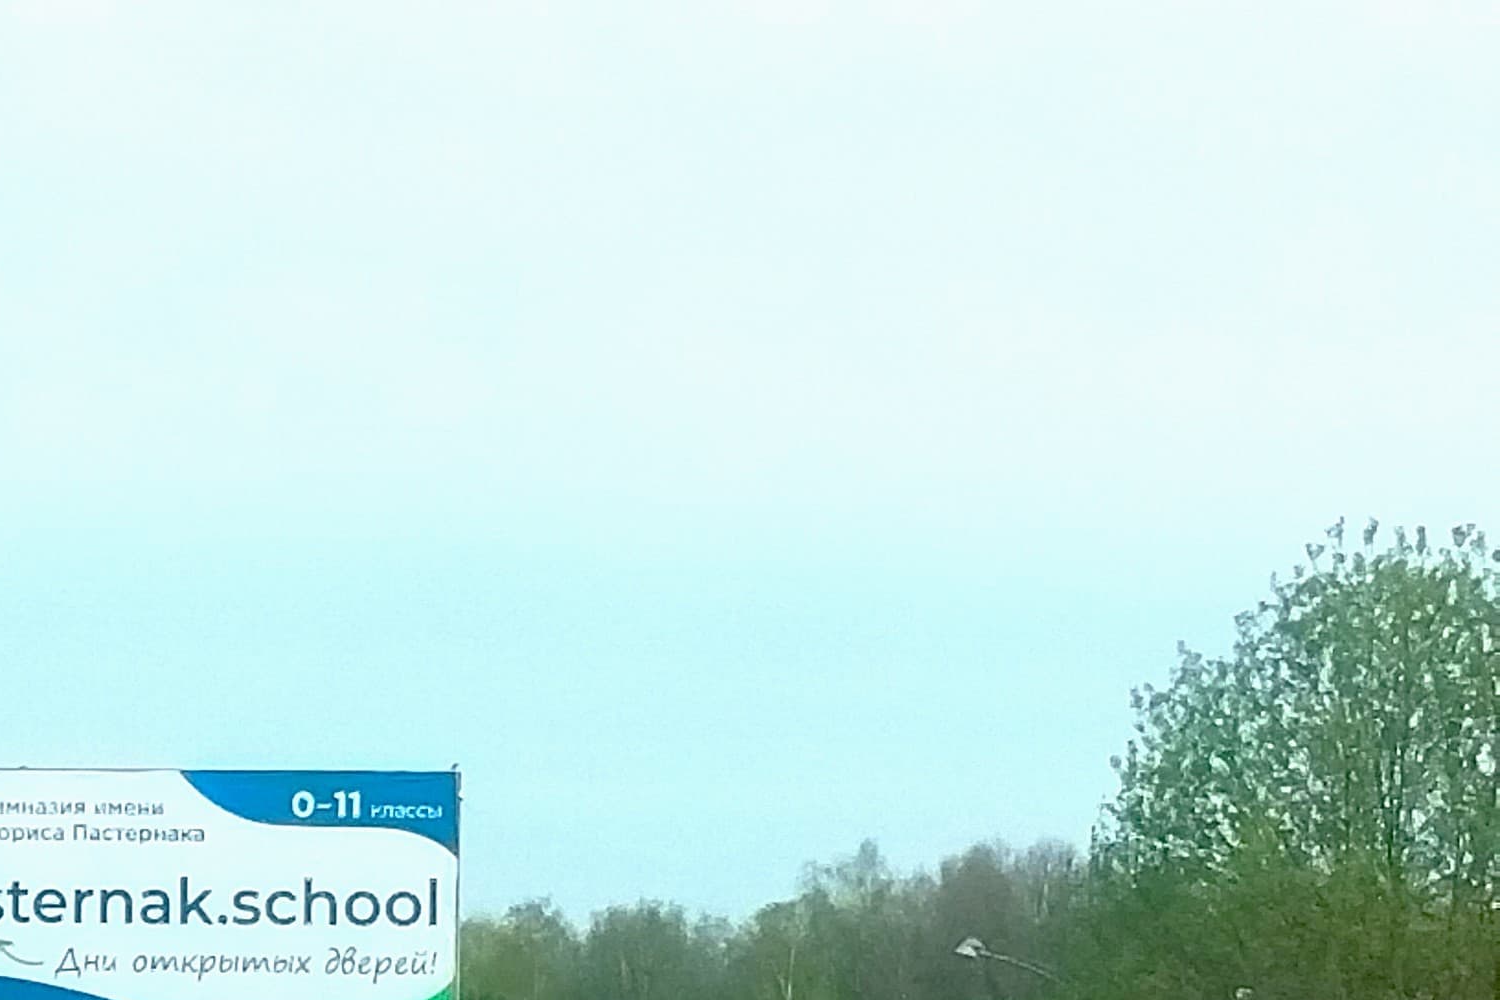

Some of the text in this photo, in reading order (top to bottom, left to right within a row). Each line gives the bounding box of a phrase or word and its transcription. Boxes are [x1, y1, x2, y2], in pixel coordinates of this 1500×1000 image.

[94, 800, 165, 816] имени
[371, 804, 443, 819] классы
[73, 824, 206, 844] Пастернака
[54, 946, 438, 984] Дни открытых дверей!
